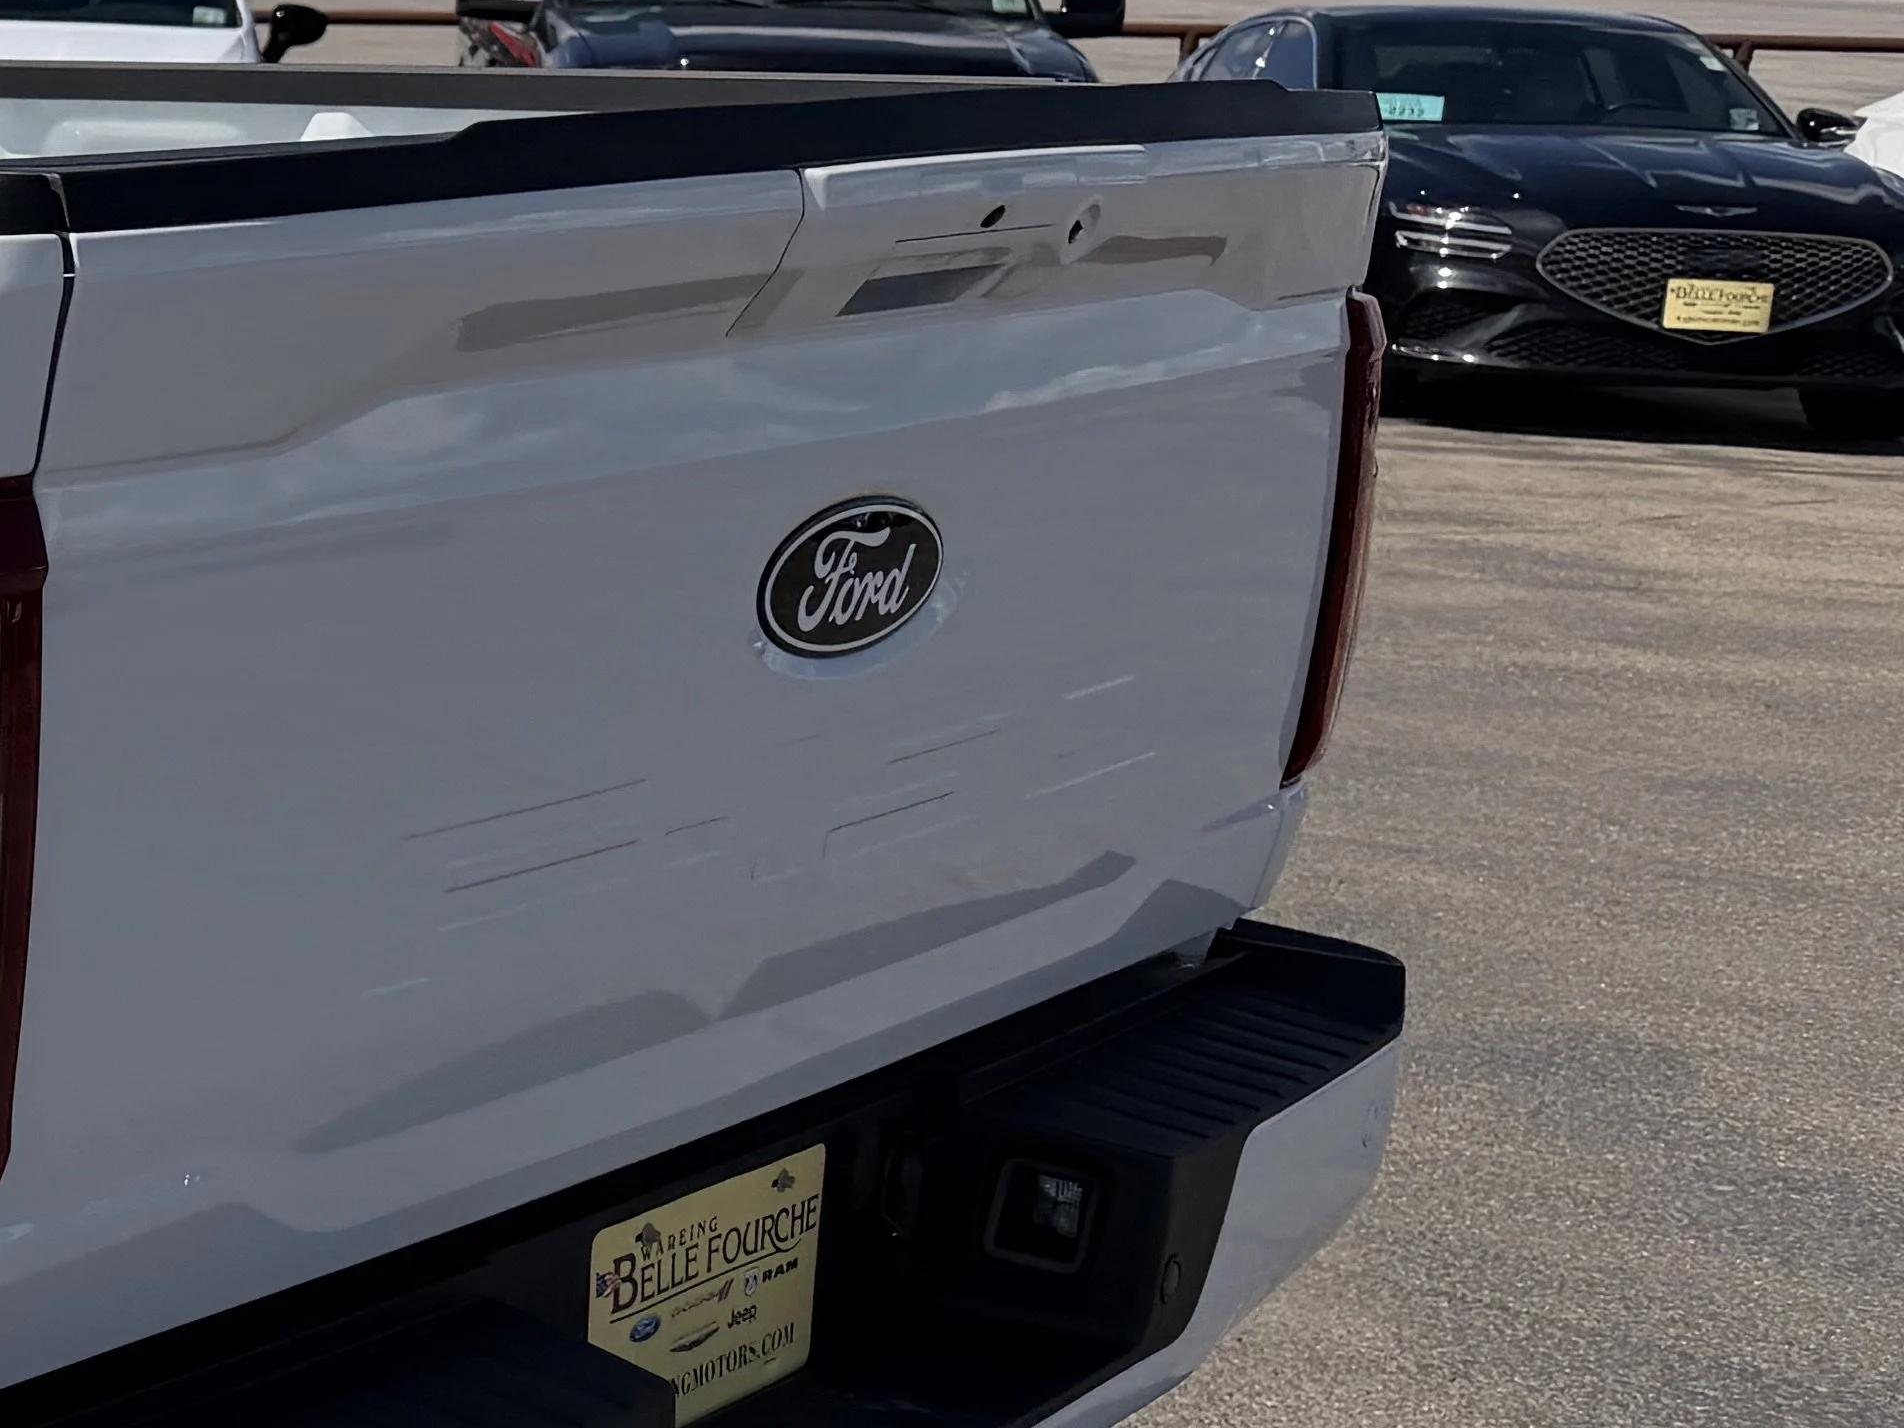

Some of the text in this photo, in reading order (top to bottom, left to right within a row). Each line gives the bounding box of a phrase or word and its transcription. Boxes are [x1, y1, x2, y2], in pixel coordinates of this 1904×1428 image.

[797, 526, 917, 633] Ford
[611, 1194, 819, 1314] BELLE FOURCHE
[641, 1216, 718, 1261] WAREING
[762, 1257, 798, 1283] RAM
